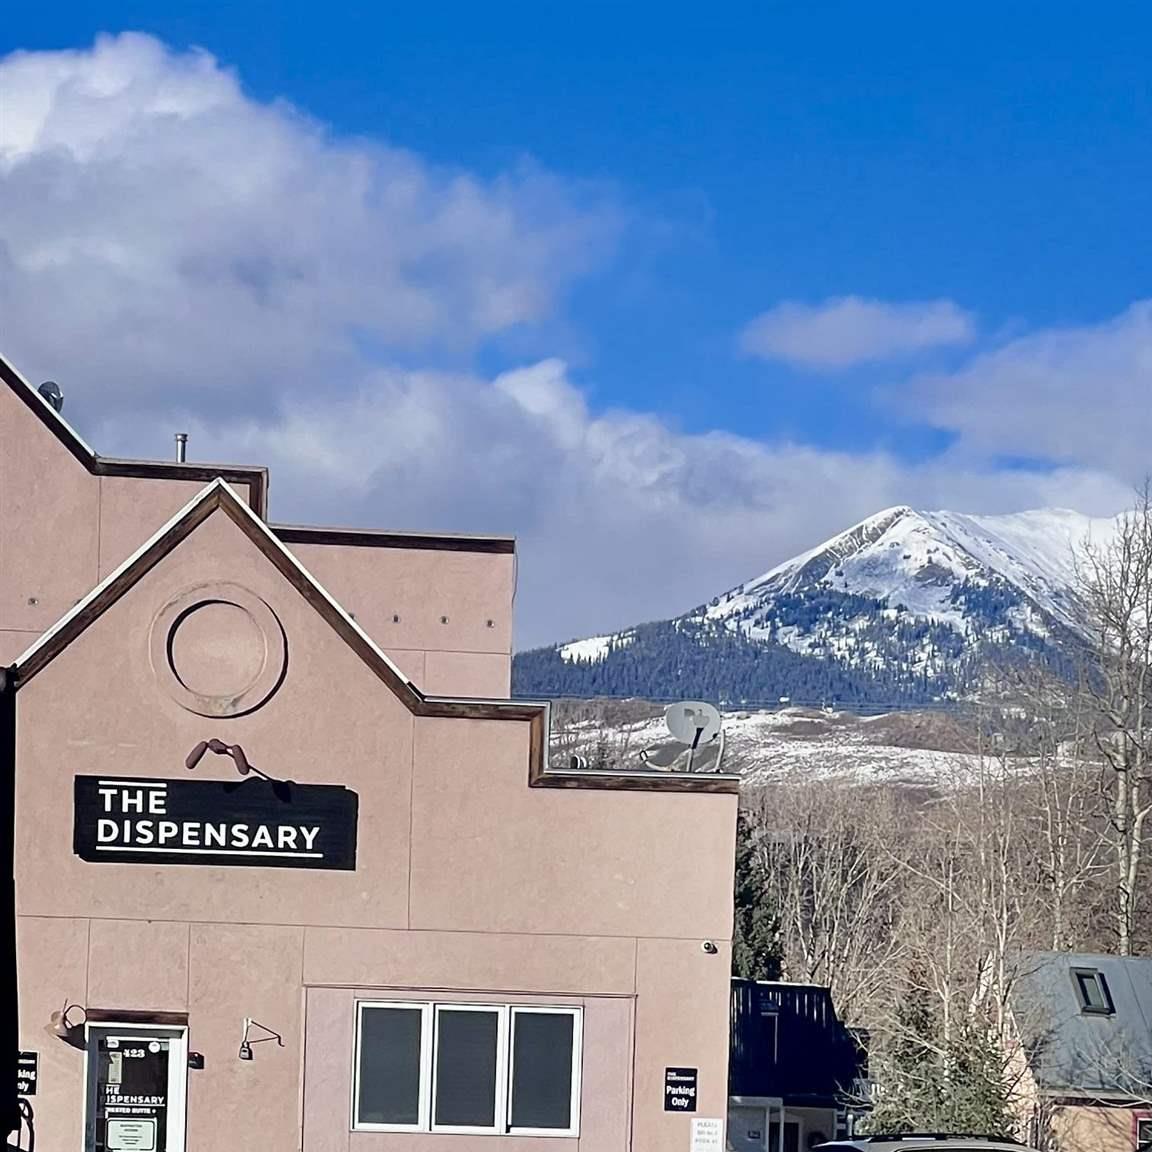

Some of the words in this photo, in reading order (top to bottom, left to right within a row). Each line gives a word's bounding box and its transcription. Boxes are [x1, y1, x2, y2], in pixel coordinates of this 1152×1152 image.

[98, 788, 167, 815] THE
[96, 818, 321, 850] DISPENSARY
[17, 1069, 36, 1080] king
[105, 1086, 120, 1095] HE
[666, 1086, 695, 1097] Parking
[106, 1095, 164, 1104] ISPENSARY
[671, 1097, 689, 1108] Only
